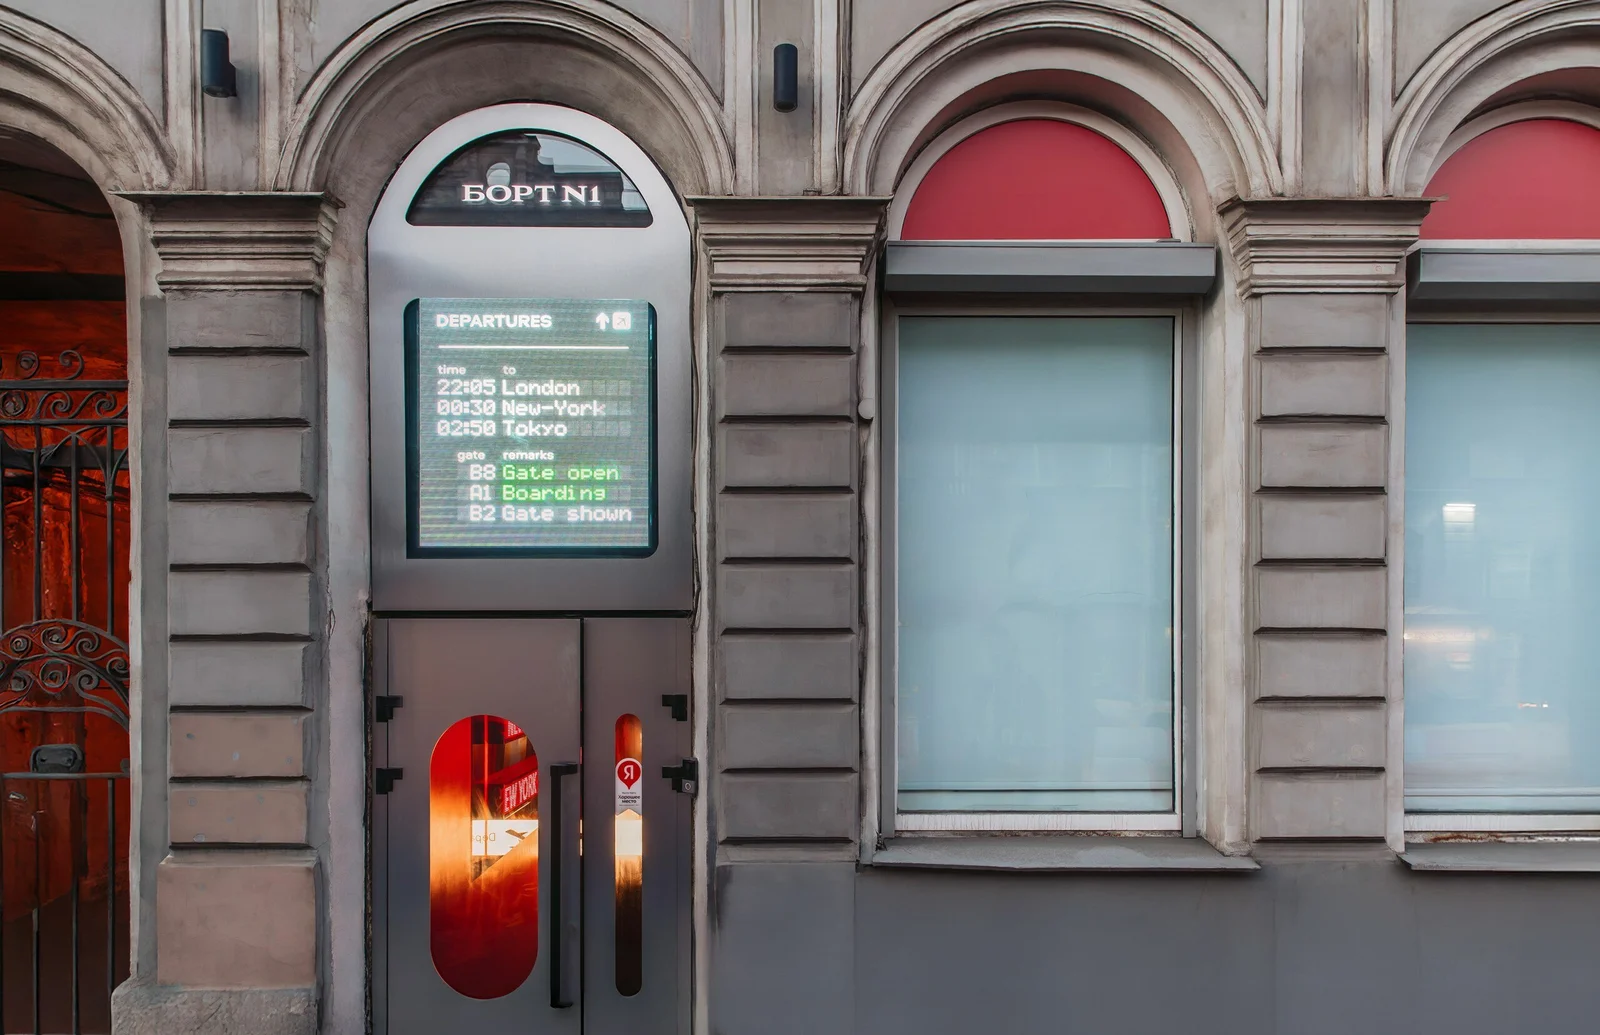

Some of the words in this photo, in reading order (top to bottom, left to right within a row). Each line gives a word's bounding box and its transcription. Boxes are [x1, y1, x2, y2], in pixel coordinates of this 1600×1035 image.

[461, 184, 555, 203] БОРТ
[561, 185, 600, 203] N1
[436, 314, 552, 328] DEPARTURES
[437, 364, 467, 375] time
[502, 365, 517, 375] to
[437, 379, 496, 396] 22:05
[501, 379, 580, 396] London
[437, 399, 496, 416] 00:30
[501, 399, 606, 416] New-York
[437, 419, 496, 436] 02:50
[501, 419, 568, 436] Tokyo
[457, 450, 486, 462] gate
[502, 450, 555, 460] remarks
[469, 464, 496, 480] B8
[502, 464, 554, 480] Gate
[567, 468, 619, 480] open
[469, 484, 492, 501] A1
[502, 484, 606, 501] Boarding
[469, 504, 496, 521] B2
[501, 504, 555, 521] Gate
[567, 505, 632, 521] shown
[623, 764, 634, 780] Я
